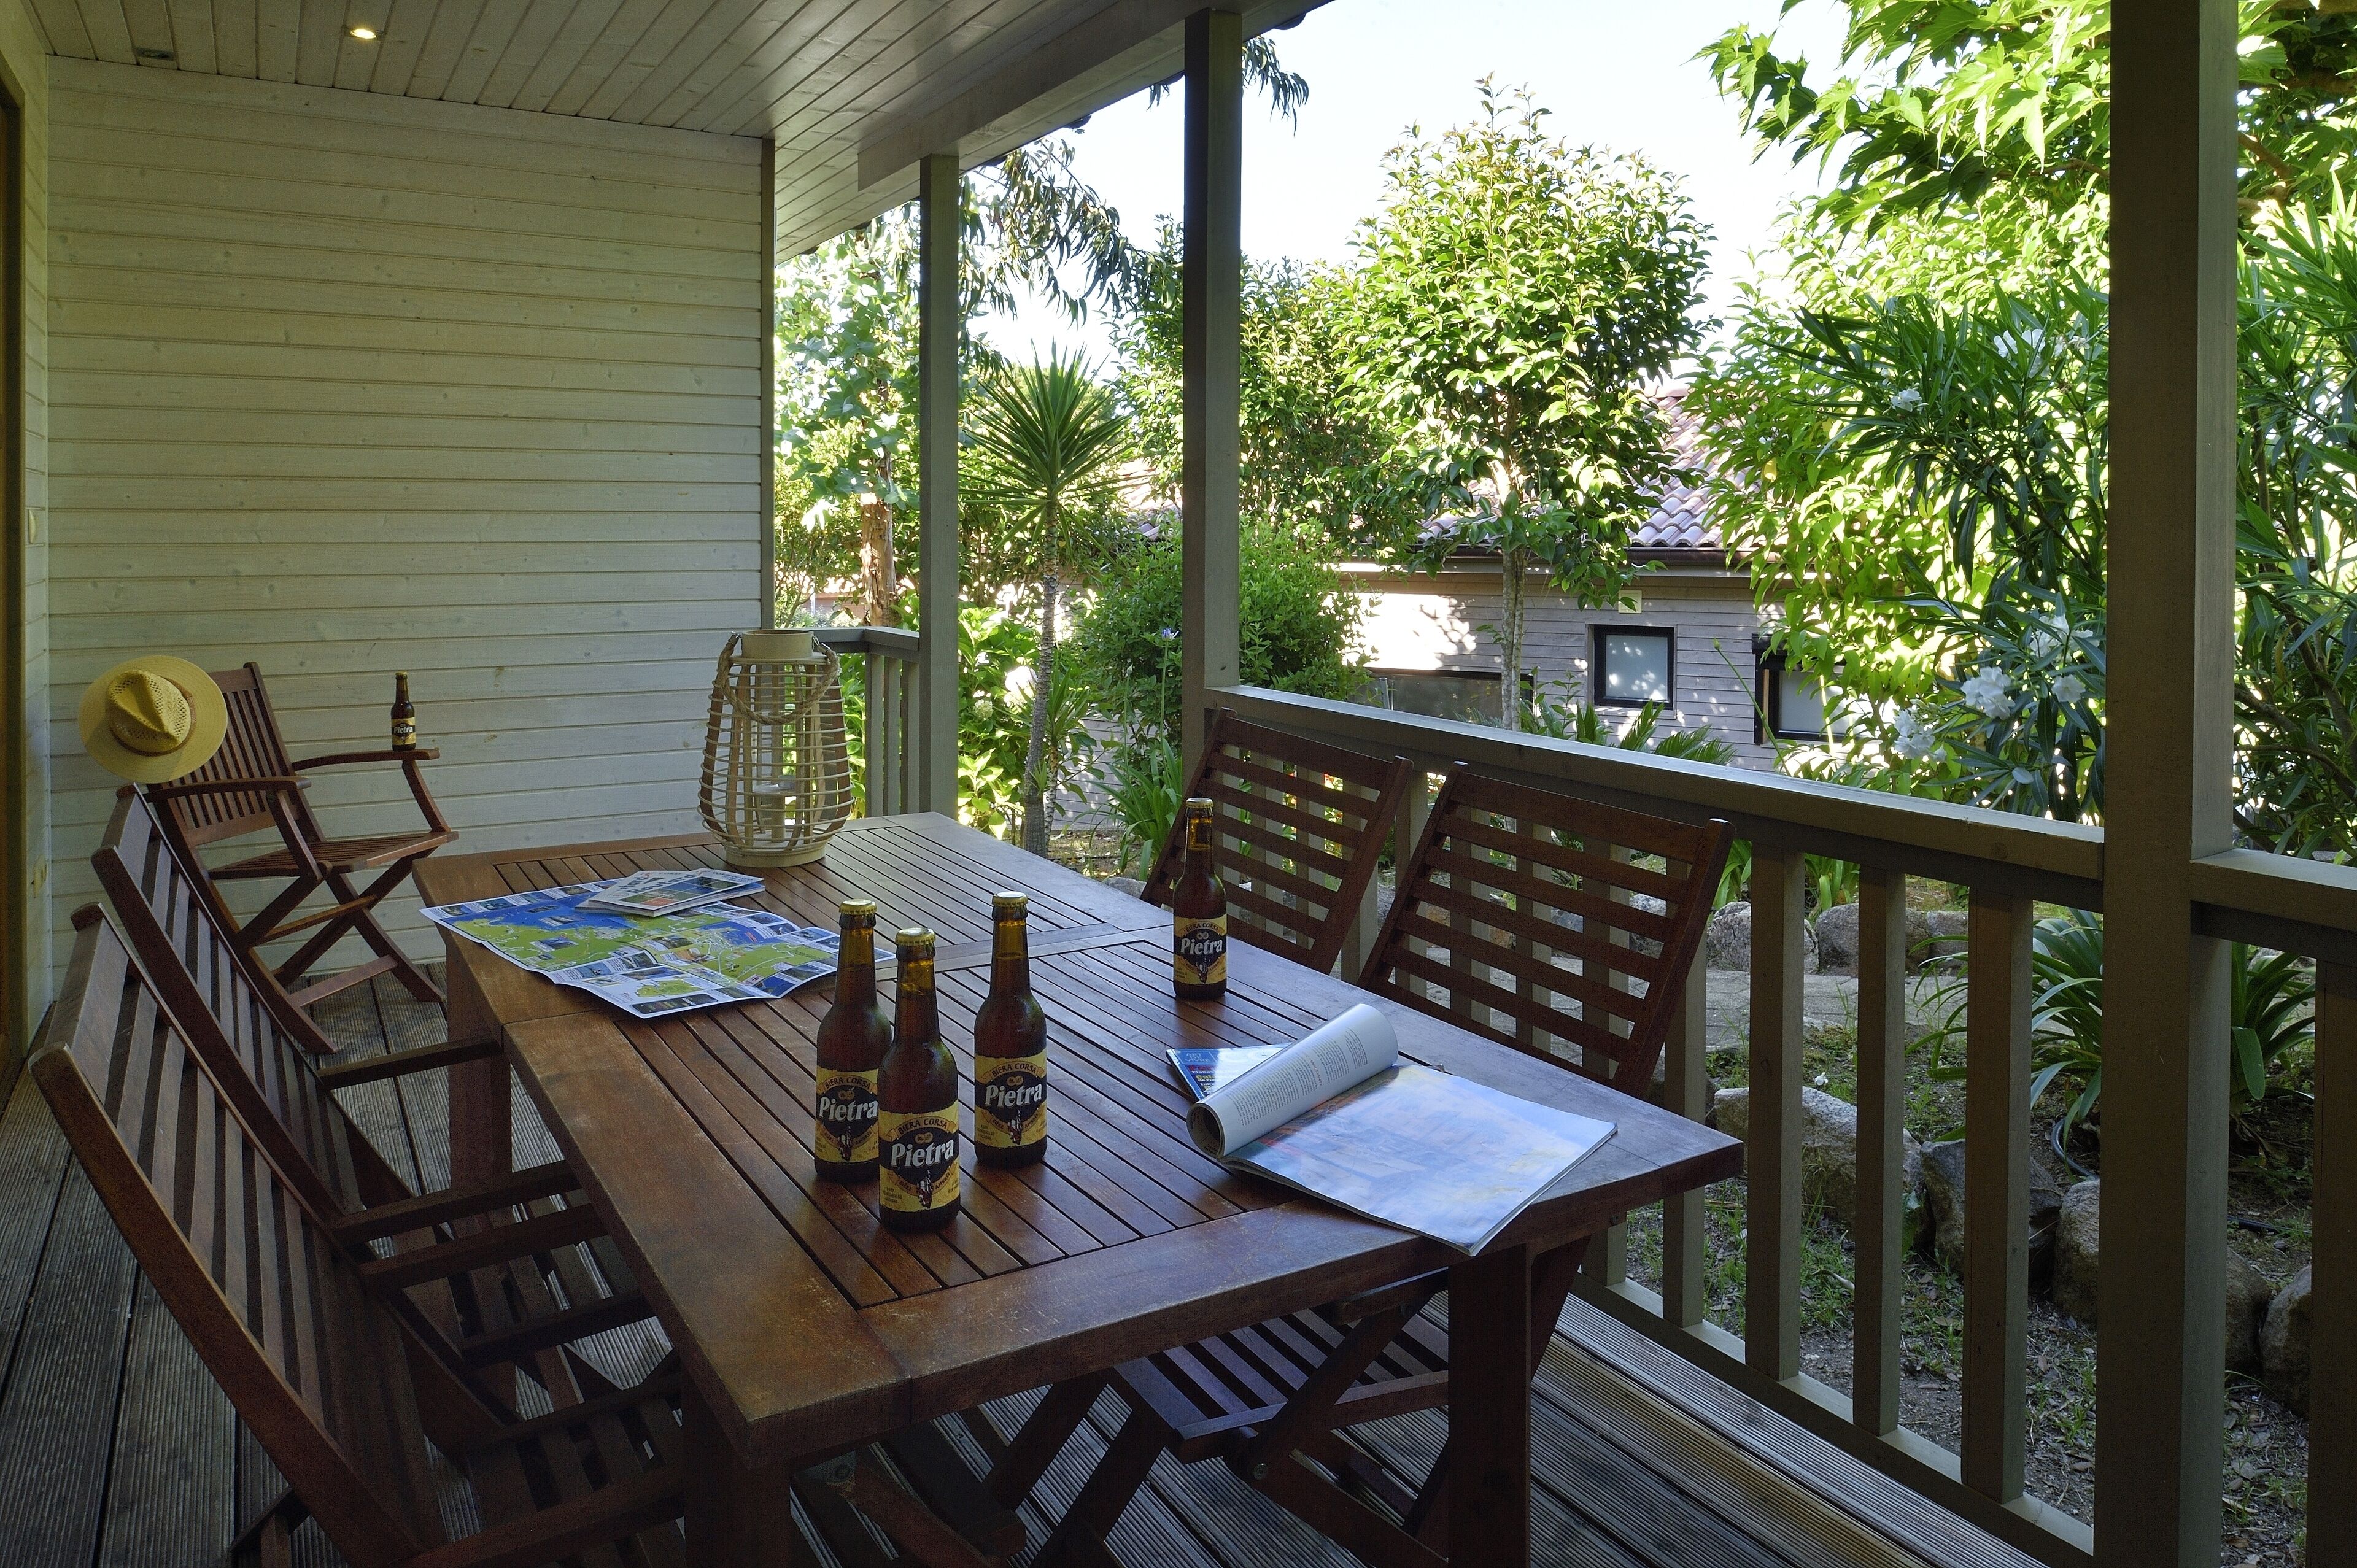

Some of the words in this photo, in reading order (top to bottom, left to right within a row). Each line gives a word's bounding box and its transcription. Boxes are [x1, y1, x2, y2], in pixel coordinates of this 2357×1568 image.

[627, 873, 697, 894] Routard
[1186, 923, 1201, 933] BIERA
[1202, 922, 1219, 931] CORSA
[1180, 938, 1223, 955] Pietra
[991, 1064, 1013, 1077] BIERA
[1015, 1062, 1036, 1073] CORSA
[825, 1077, 845, 1089] BIERA
[846, 1076, 872, 1091] CORSA
[985, 1084, 1042, 1108] Pietra
[819, 1096, 878, 1122] Pietra
[898, 1119, 921, 1134] BIERA
[923, 1118, 948, 1128] CORSA
[891, 1139, 954, 1167] Pietra
